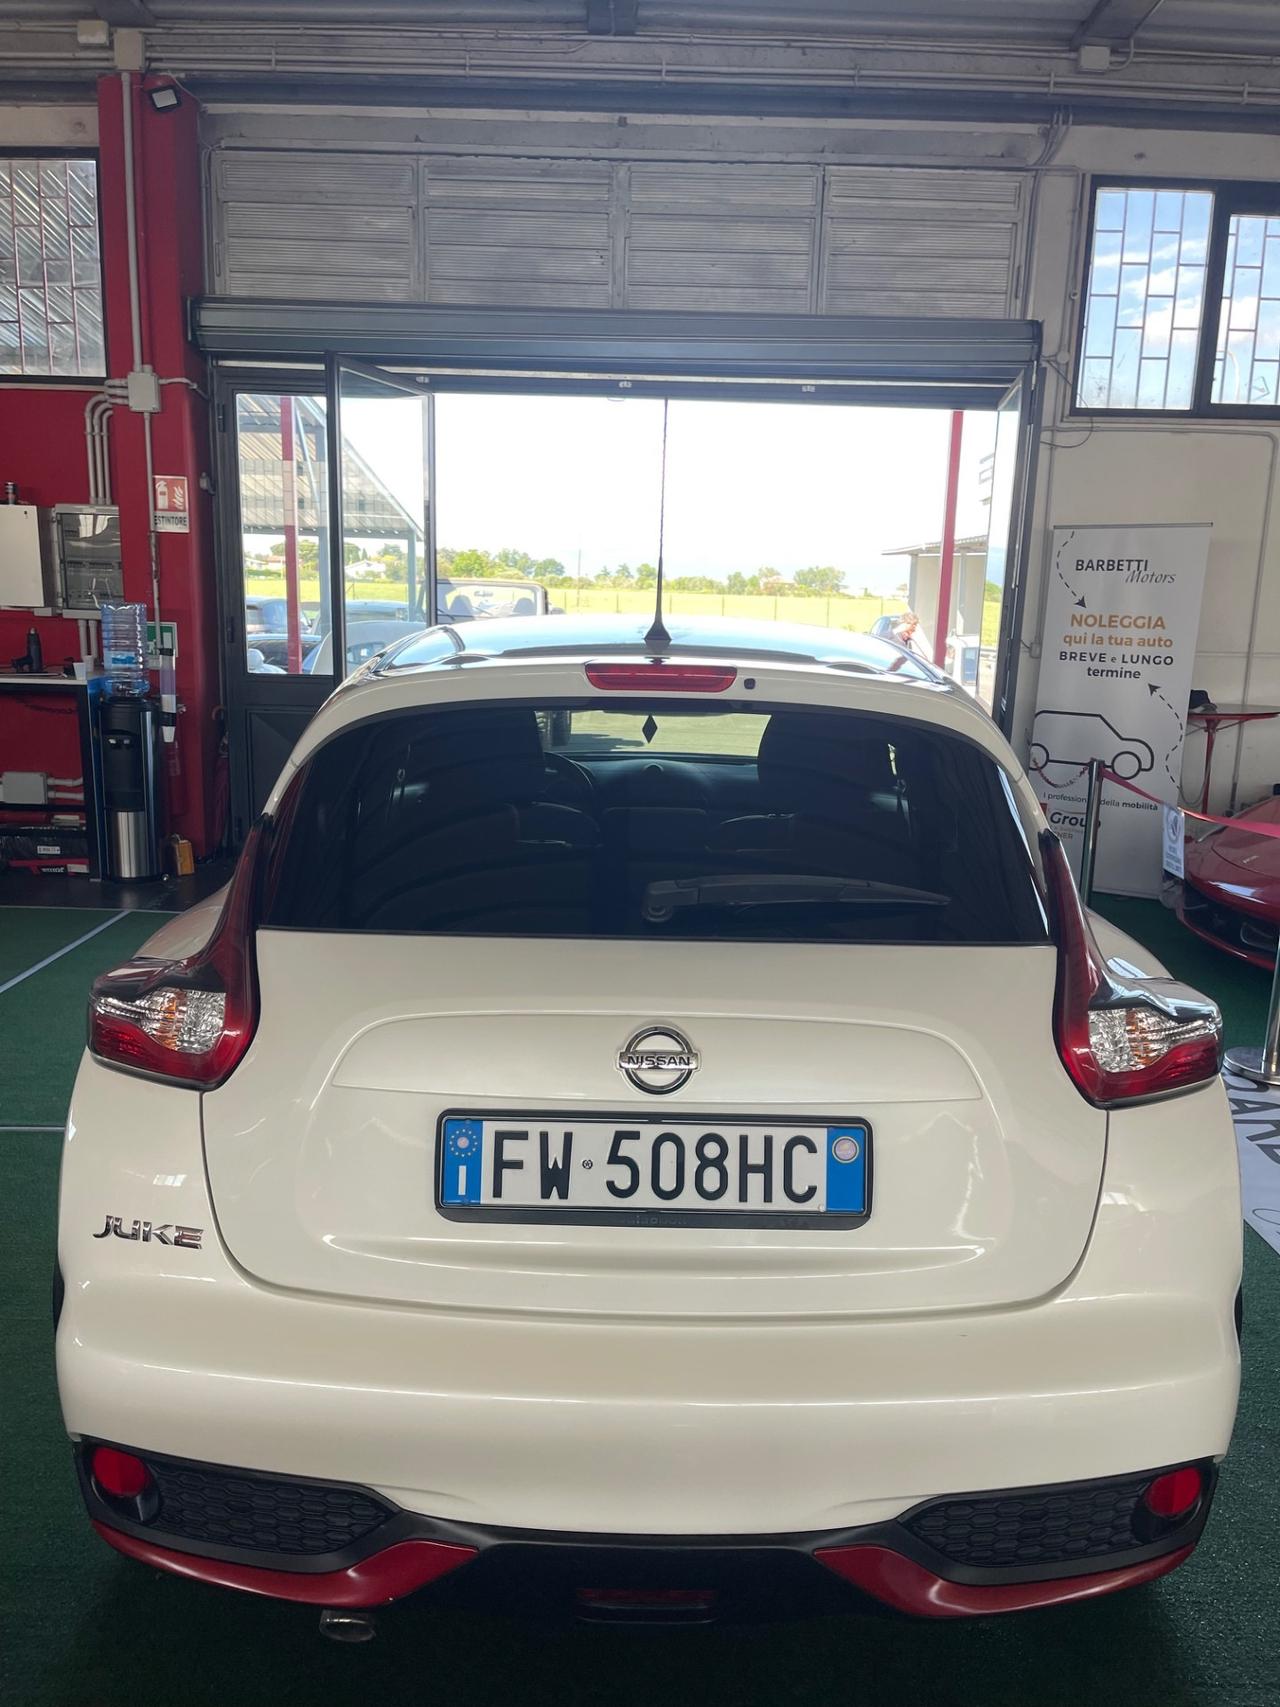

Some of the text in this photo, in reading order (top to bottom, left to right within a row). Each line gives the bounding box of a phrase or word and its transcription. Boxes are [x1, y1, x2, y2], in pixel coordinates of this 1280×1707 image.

[153, 515, 187, 526] ESTINTORE
[1075, 559, 1148, 572] BARBETTI
[1125, 570, 1177, 584] Motors
[1070, 614, 1166, 630] NOLEGGIA
[1063, 633, 1173, 648] qui la tua auto
[1059, 651, 1107, 663] BREVE
[1121, 653, 1174, 666] LUNGO
[1087, 667, 1141, 680] termine
[1100, 799, 1120, 808] della
[1121, 802, 1159, 812] mobilità
[628, 1055, 690, 1067] NISSAN
[492, 1130, 573, 1200] FW
[606, 1130, 818, 1204] 508HC
[92, 1215, 204, 1250] JUKE
